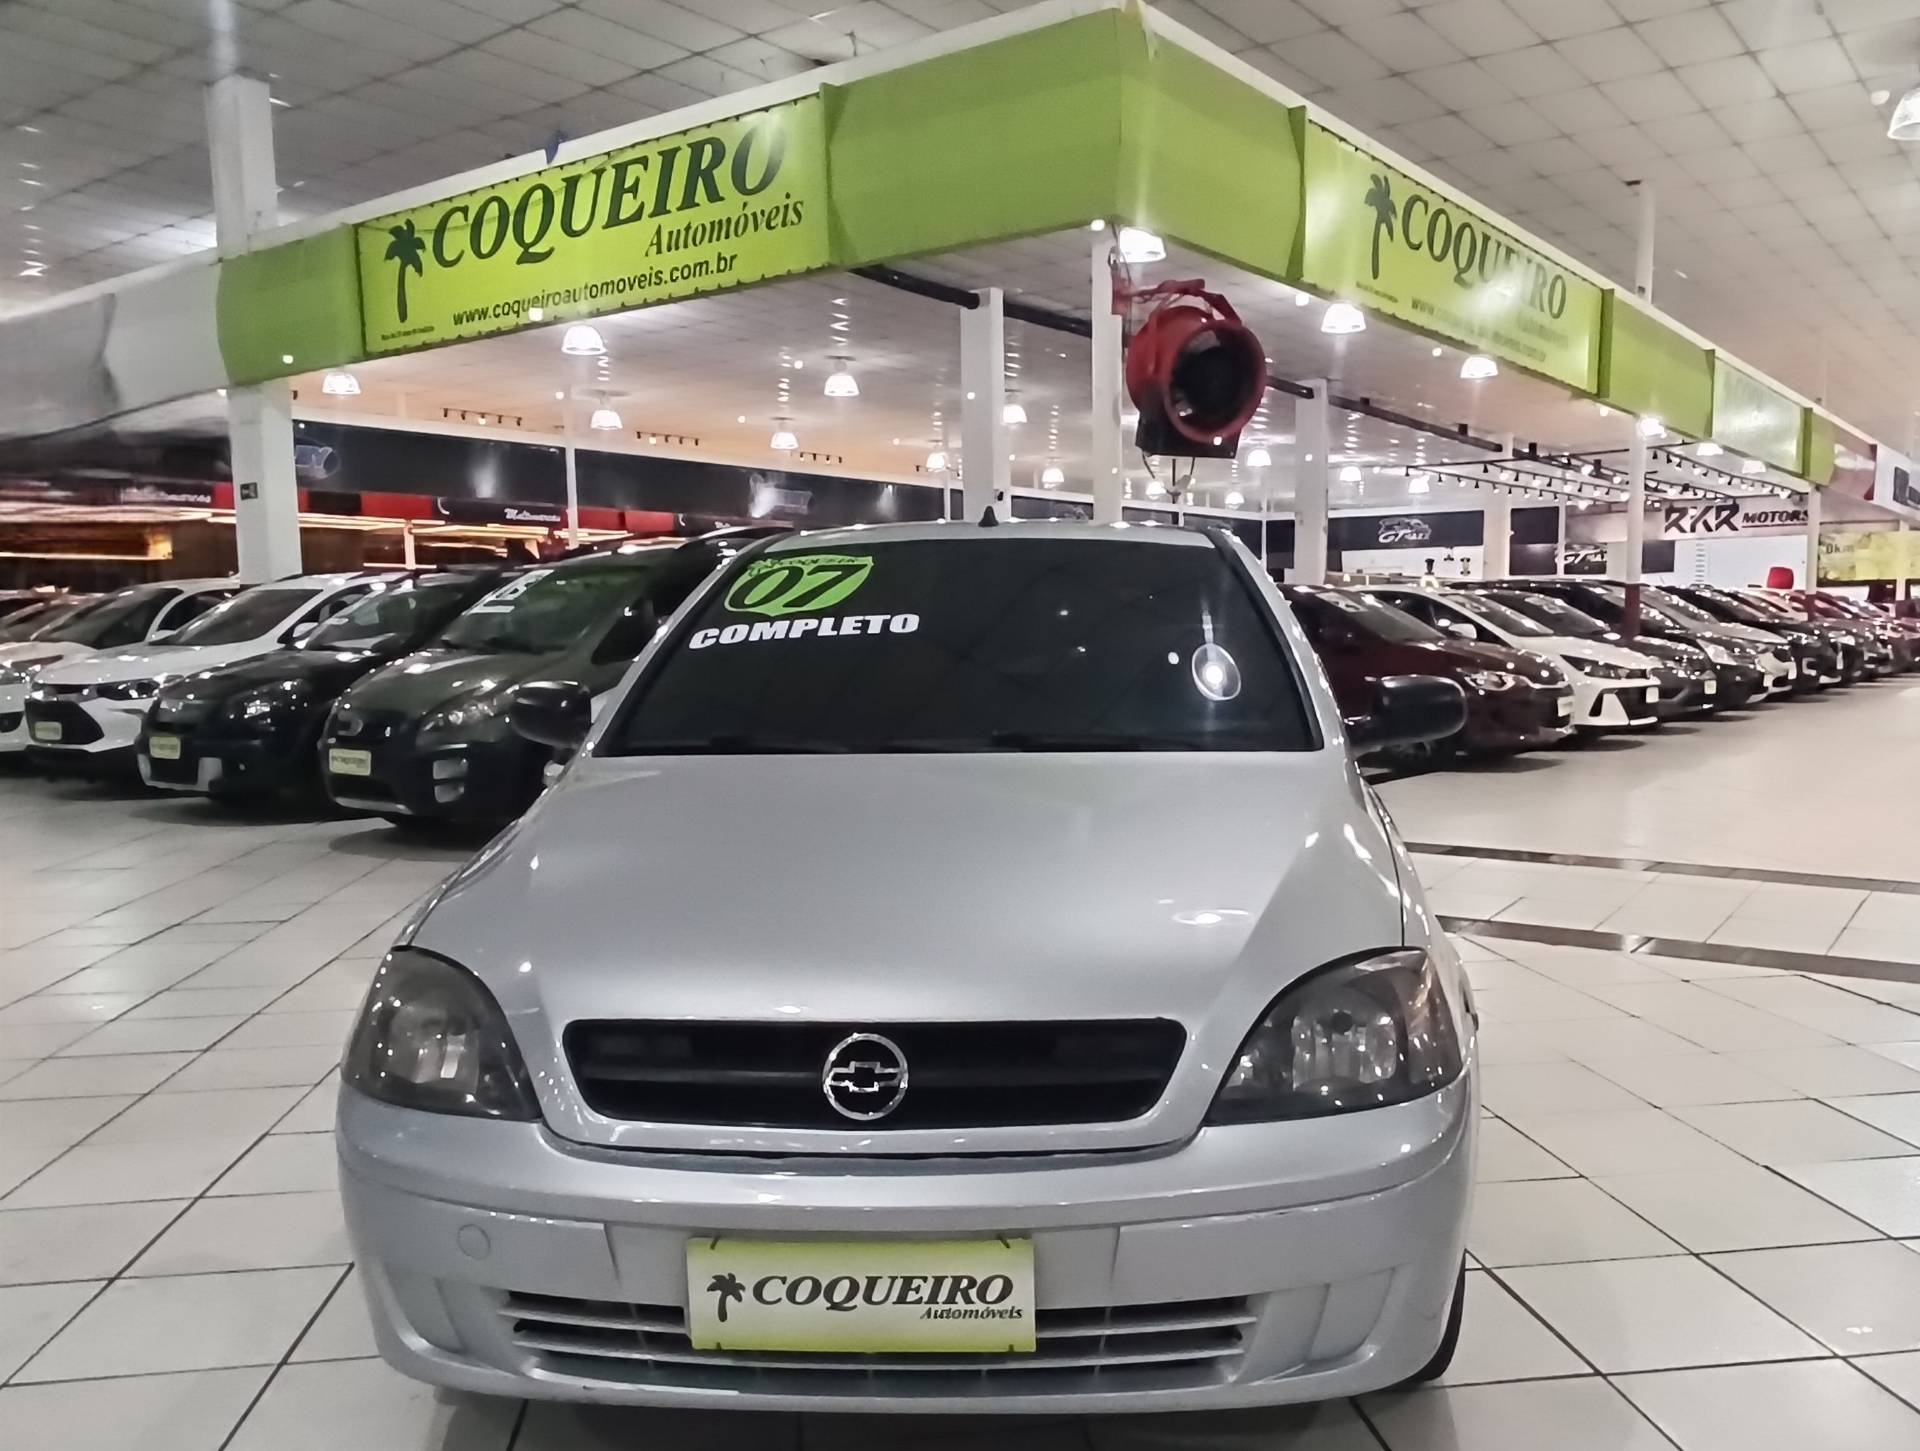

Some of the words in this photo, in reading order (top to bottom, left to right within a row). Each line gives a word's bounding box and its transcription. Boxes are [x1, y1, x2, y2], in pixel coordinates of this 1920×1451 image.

[433, 121, 787, 266] COQUEIRO
[645, 191, 804, 257] Automóveis
[452, 251, 737, 325] www.coqueiroautomoveis.com.br
[728, 563, 869, 610] 07
[688, 613, 921, 650] COMPLETO
[752, 1274, 1014, 1312] COQUEIRO
[920, 1305, 1023, 1320] Automóveis
